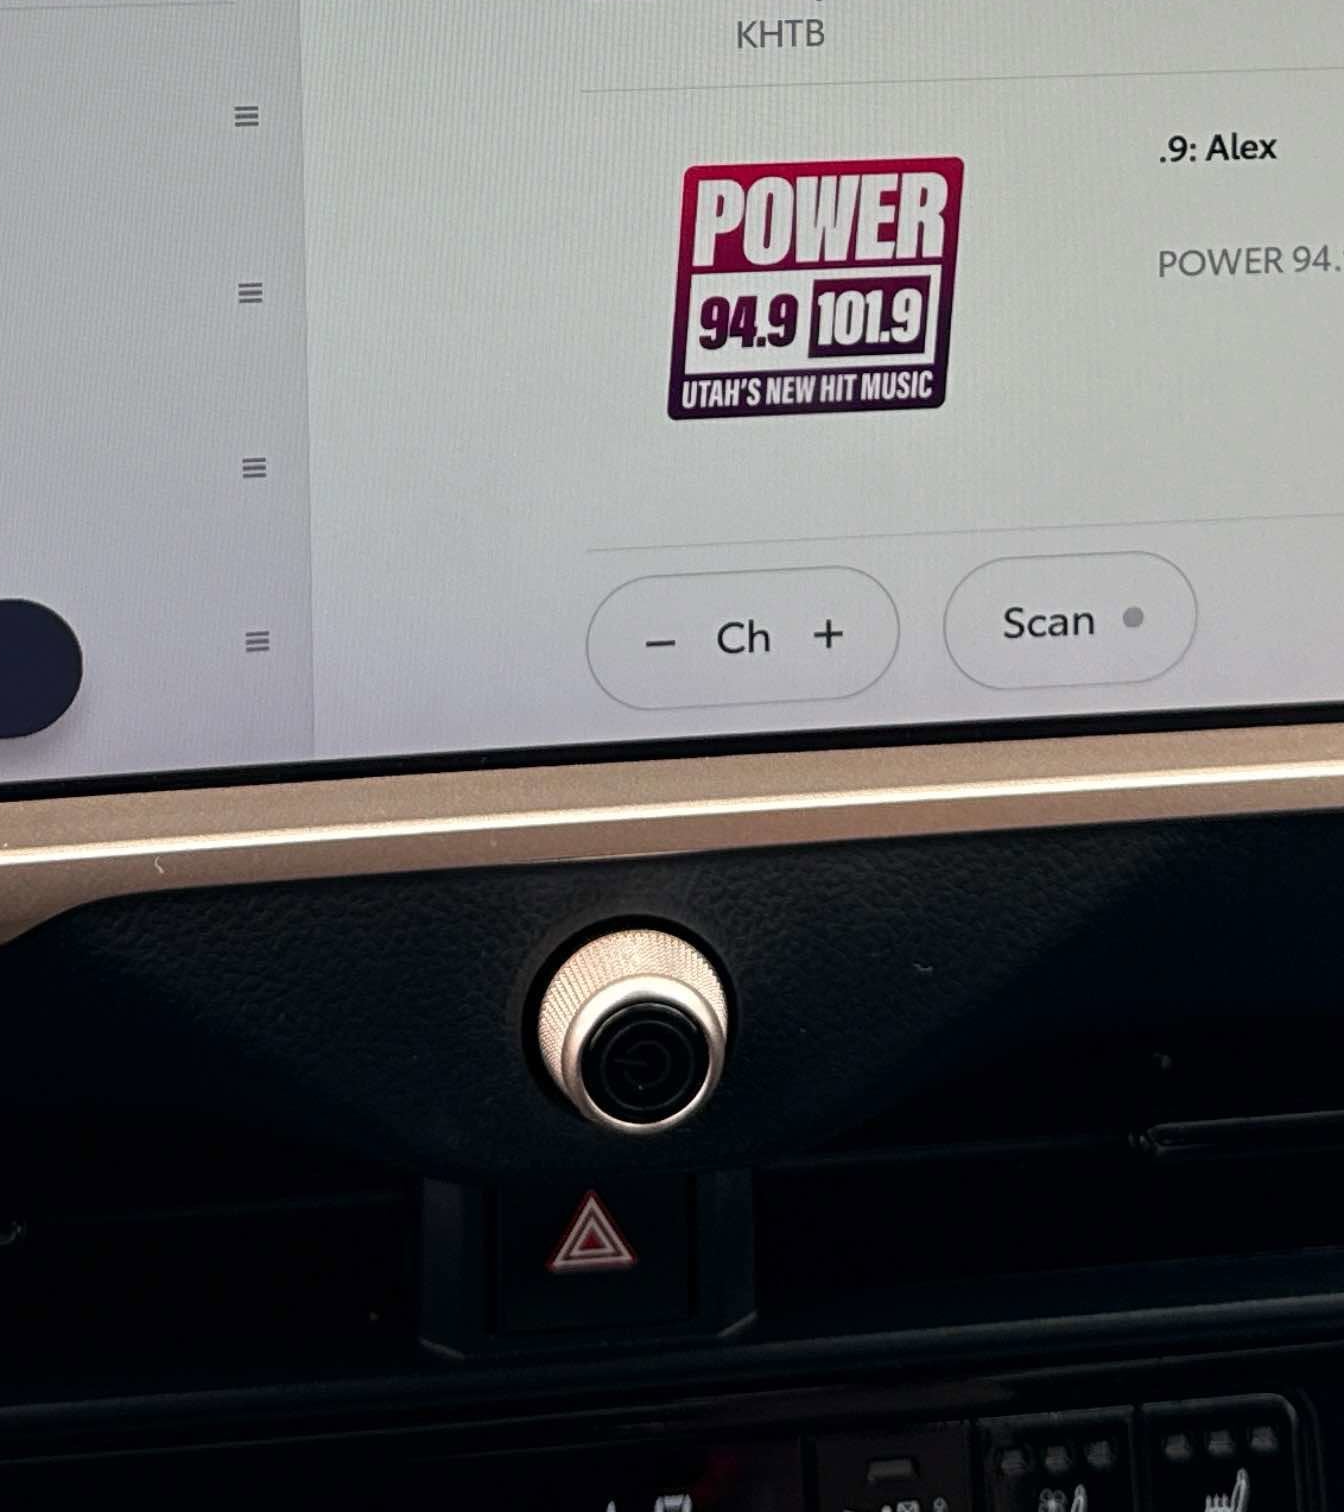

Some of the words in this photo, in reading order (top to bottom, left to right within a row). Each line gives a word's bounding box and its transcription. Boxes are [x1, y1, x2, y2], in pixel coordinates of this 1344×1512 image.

[737, 18, 825, 49] KHTB
[1159, 134, 1197, 163] .9:
[1205, 132, 1278, 161] Alex
[692, 171, 949, 267] POWER
[1159, 246, 1284, 278] POWER
[698, 292, 799, 350] 94.9
[817, 287, 923, 346] 101.9
[681, 376, 761, 409] UTAH'S
[765, 374, 816, 405] NEW
[820, 373, 856, 403] HIT
[860, 370, 933, 400] MUSIC
[716, 617, 771, 655] Ch
[1002, 605, 1096, 640] Scan
